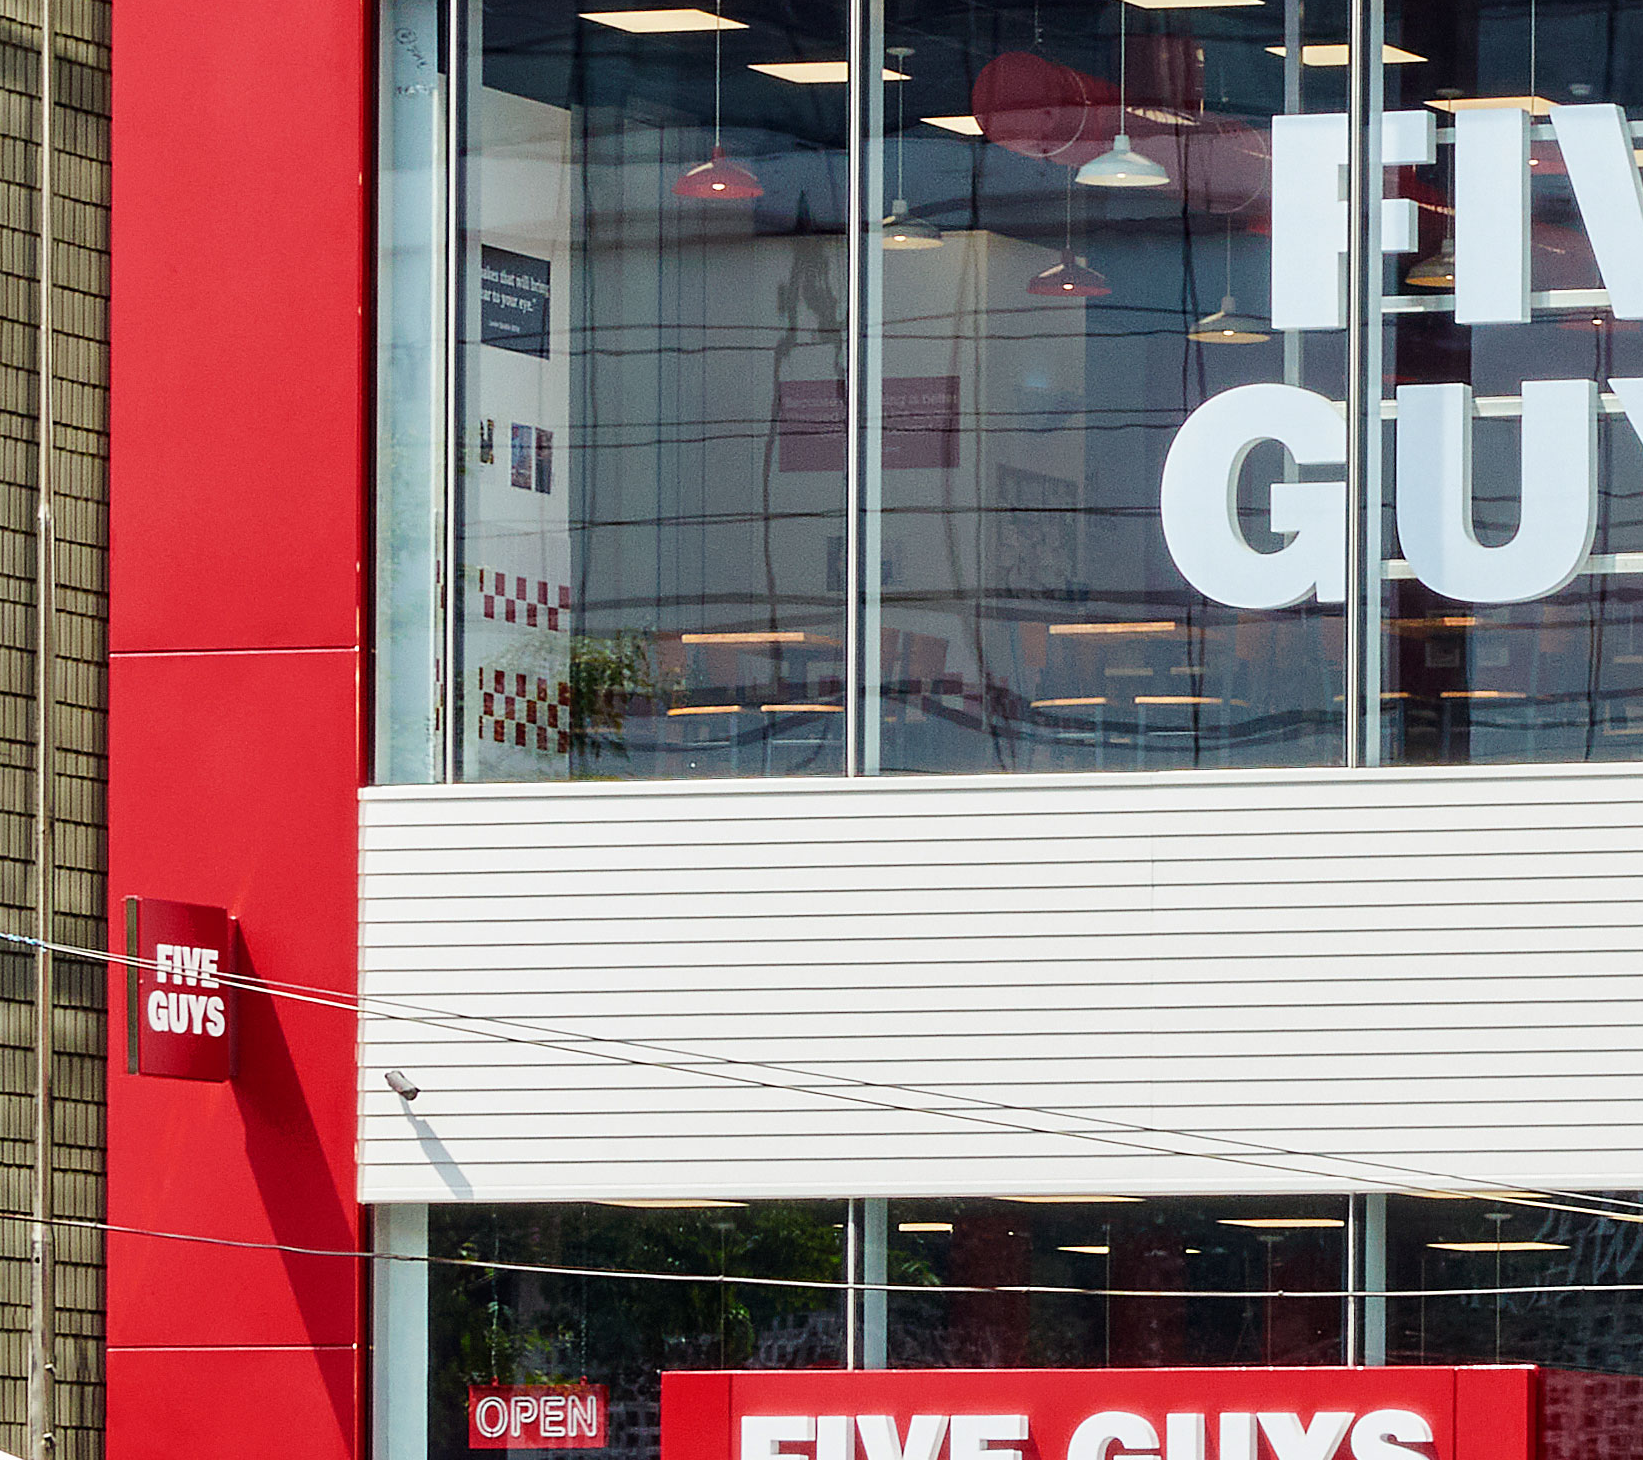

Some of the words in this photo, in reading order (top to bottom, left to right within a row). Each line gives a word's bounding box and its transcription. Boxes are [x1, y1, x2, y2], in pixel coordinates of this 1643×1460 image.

[156, 943, 220, 989] FIVE
[147, 990, 226, 1037] GUYS
[475, 1393, 598, 1440] OPEN
